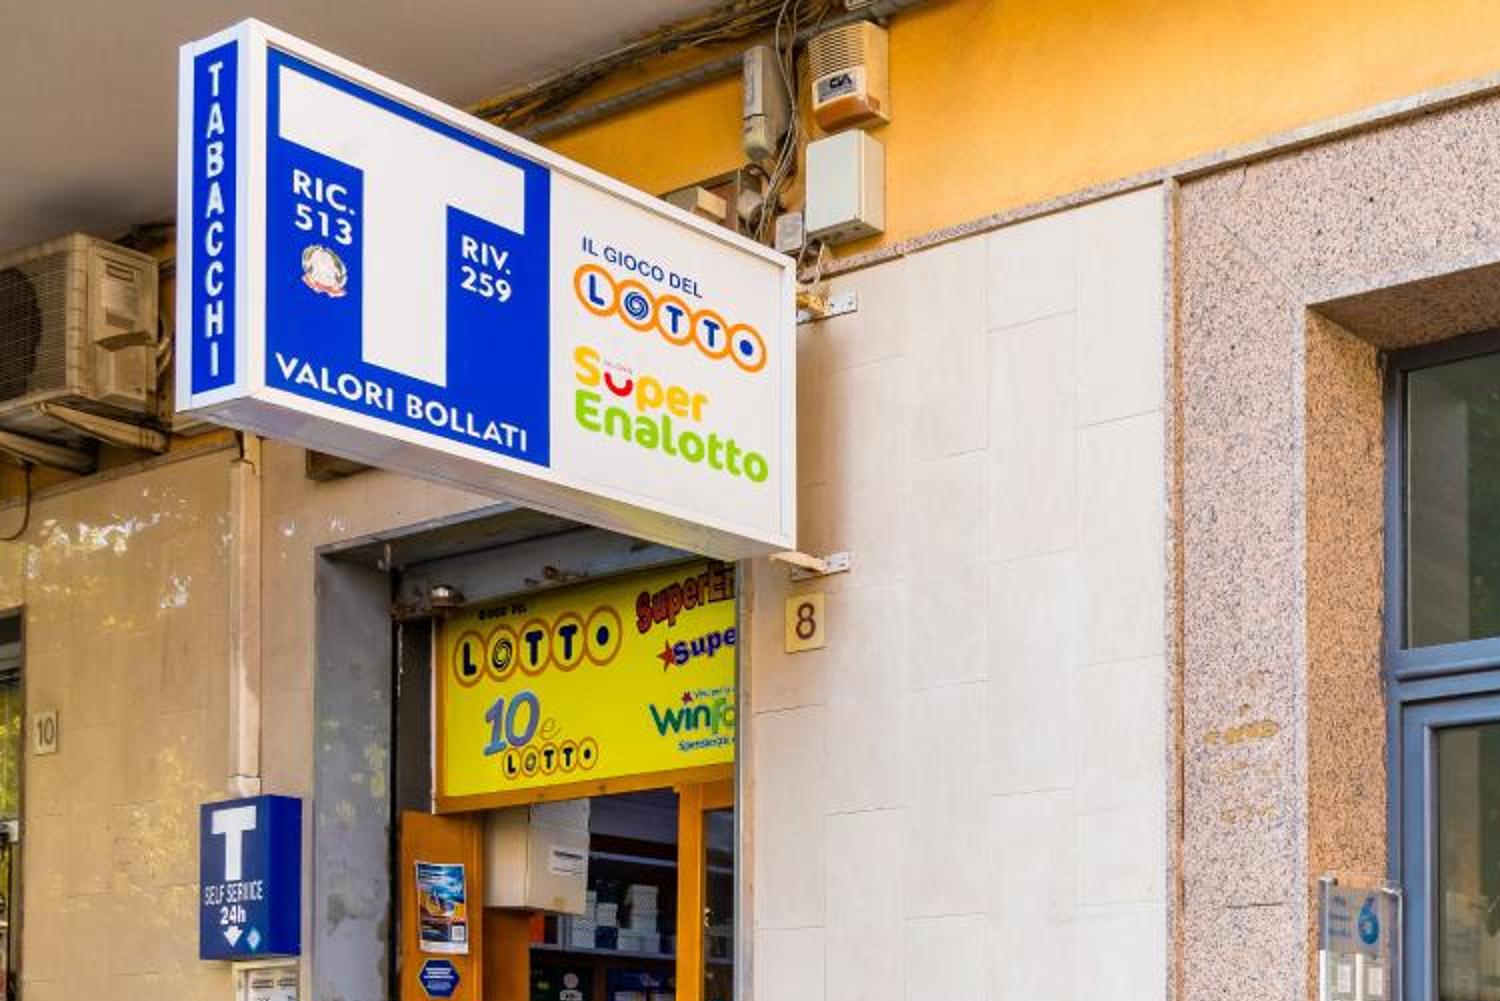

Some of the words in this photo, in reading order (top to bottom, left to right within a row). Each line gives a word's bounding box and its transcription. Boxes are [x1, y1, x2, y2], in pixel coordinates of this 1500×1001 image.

[205, 60, 225, 377] TABACCHI
[292, 168, 356, 215] RIC.
[278, 63, 525, 389] T
[294, 202, 353, 246] 513
[461, 233, 512, 276] RIV.
[460, 265, 513, 304] 259
[582, 235, 599, 258] IL
[603, 246, 665, 283] GIOCO
[669, 272, 703, 299] DEL
[576, 265, 766, 372] LOTTO
[274, 351, 394, 412] VALORI
[405, 393, 528, 453] BOLLATI
[573, 345, 708, 422] Super
[574, 388, 769, 483] Enalotto
[455, 609, 621, 686] LOTTO
[795, 601, 817, 641] 8
[37, 716, 55, 747] 10
[483, 687, 541, 757] 10
[502, 738, 598, 779] LOTTO
[211, 805, 257, 882] T
[204, 885, 225, 906] SELF
[226, 879, 264, 903] SERVICE
[219, 905, 247, 926] 24h
